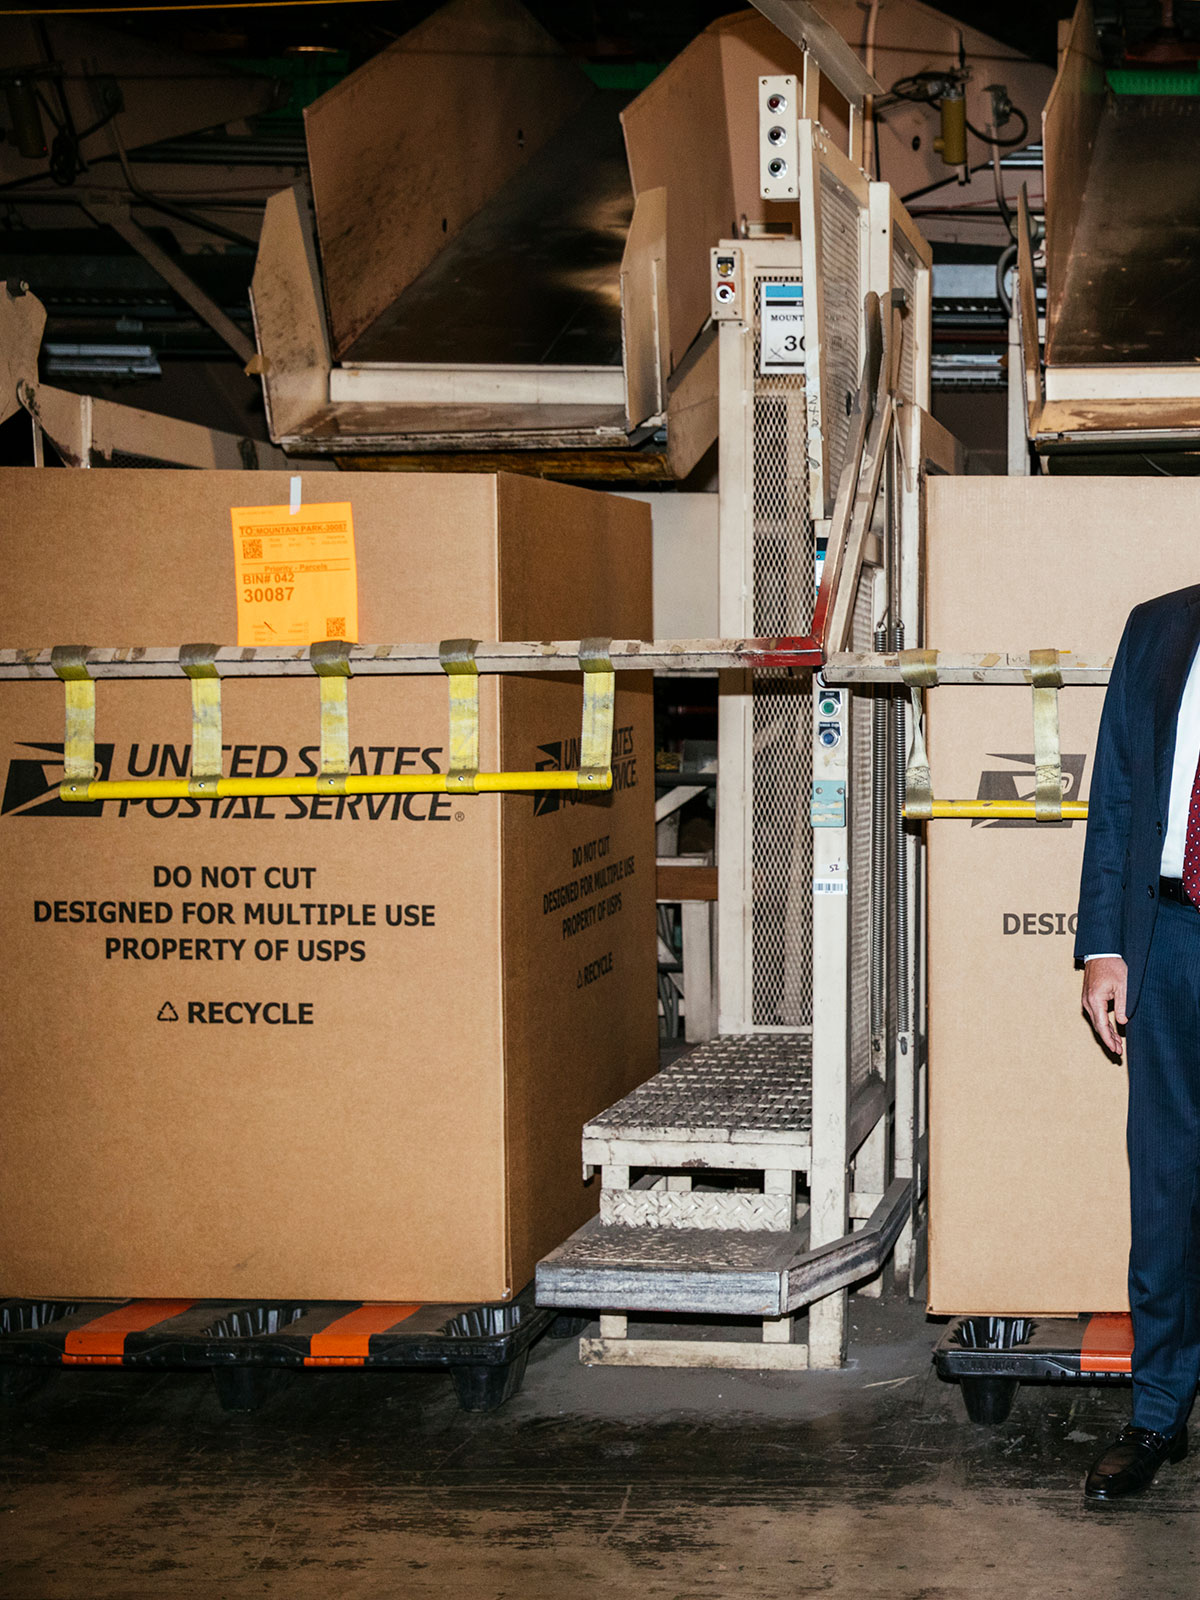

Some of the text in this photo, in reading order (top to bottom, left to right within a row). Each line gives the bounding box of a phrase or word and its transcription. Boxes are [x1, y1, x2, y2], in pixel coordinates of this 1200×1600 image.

[771, 314, 804, 322] MOUNT
[243, 572, 295, 585] BIN# 042
[264, 565, 292, 573] Priority
[243, 587, 295, 603] 30087
[584, 840, 597, 864] NOT
[598, 835, 610, 858] CUT
[153, 866, 317, 889] DO NOT CUT
[543, 855, 635, 915] DESIGNED FOR MULTIPLE USE
[33, 901, 436, 927] DESIGNED FOR MULTIPLE USE
[562, 892, 622, 940] PROPERTY OF USPS
[1003, 912, 1079, 935] DESIG
[105, 938, 366, 962] PROPERTY OF USPS
[584, 952, 613, 987] RECYCLE
[187, 1002, 314, 1025] RECYCLE
